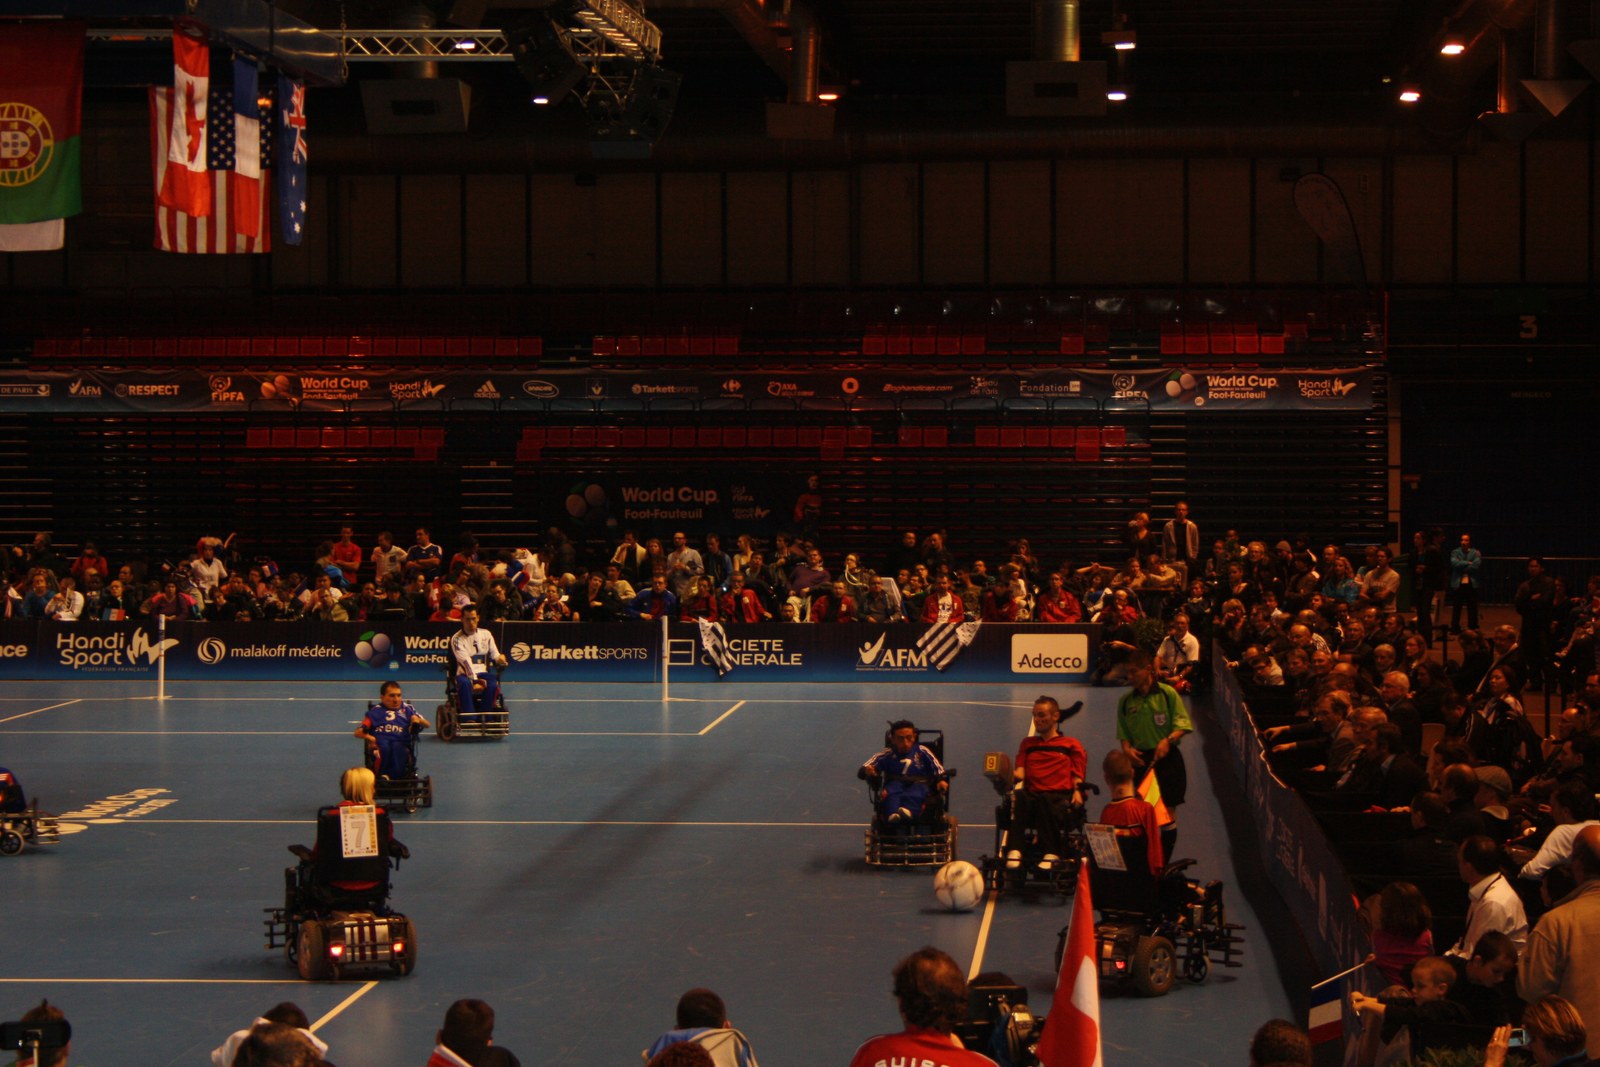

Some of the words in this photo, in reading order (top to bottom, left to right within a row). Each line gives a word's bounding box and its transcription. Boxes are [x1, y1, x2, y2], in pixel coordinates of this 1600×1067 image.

[1519, 314, 1538, 339] 3
[301, 377, 339, 389] World
[340, 377, 368, 391] Cup
[389, 381, 420, 391] Handi
[782, 383, 797, 391] AXA
[1019, 380, 1069, 392] Fondation
[1207, 375, 1246, 387] World
[1247, 375, 1277, 389] Cup
[1298, 379, 1331, 389] Handi
[80, 386, 101, 396] AFM
[128, 384, 180, 396] RESPECT
[211, 391, 245, 401] FIPFA
[391, 389, 420, 400] Sport
[473, 391, 501, 399] adidas
[1208, 390, 1266, 399] Foot-Fauteuil
[1301, 387, 1332, 398] Sport
[622, 486, 674, 502] World
[677, 486, 718, 505] Cup
[624, 508, 703, 520] Foot-Fauteuil
[56, 632, 124, 650] Handi
[404, 635, 450, 650] World
[230, 644, 286, 658] malakoff
[289, 644, 341, 658] médéric
[531, 643, 648, 660] TarkettSPORTS
[60, 650, 122, 669] Sport
[405, 654, 449, 664] Foot-Fau
[701, 653, 803, 666] GNERALE
[879, 648, 928, 667] AFM
[1018, 653, 1082, 668] Adecco
[385, 710, 396, 721] 3
[899, 758, 912, 775] 7
[351, 820, 366, 848] 7
